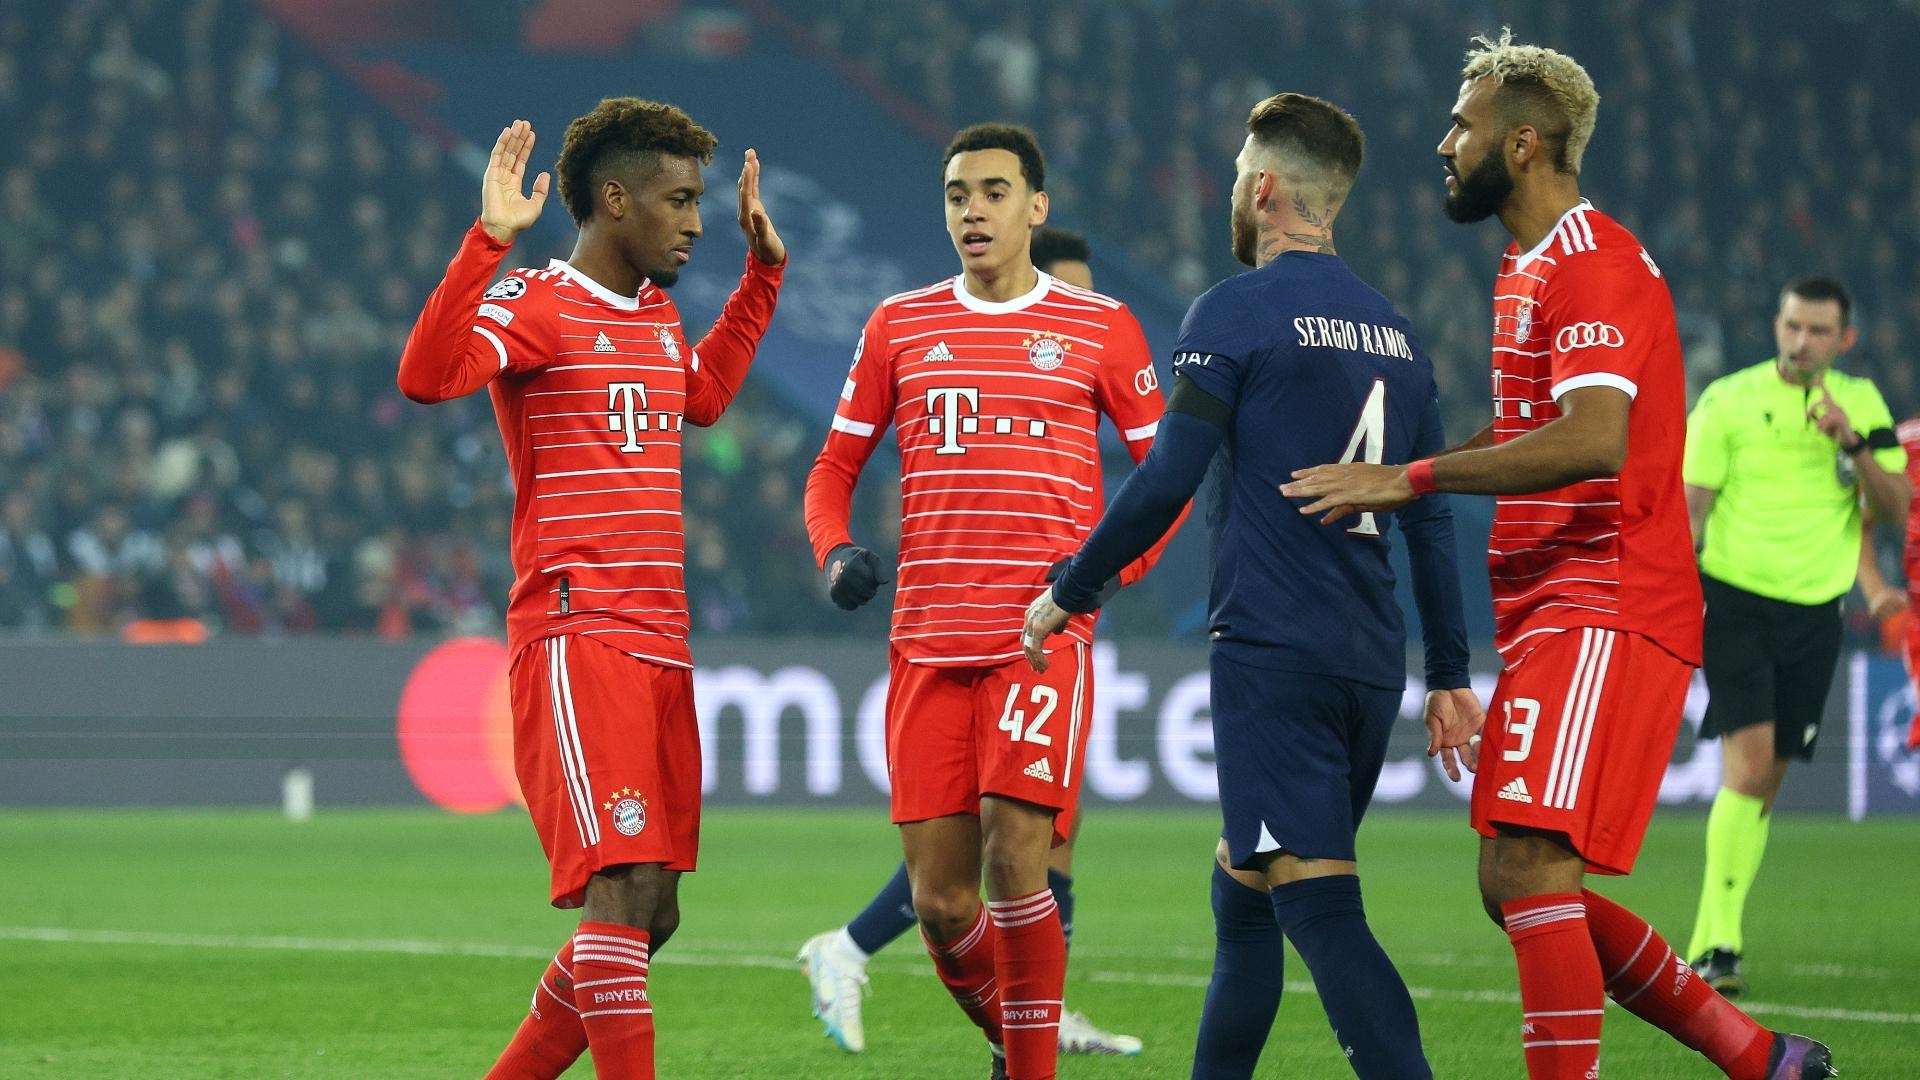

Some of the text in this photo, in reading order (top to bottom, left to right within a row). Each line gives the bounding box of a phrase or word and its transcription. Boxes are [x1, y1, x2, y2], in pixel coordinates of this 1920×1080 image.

[1294, 317, 1414, 361] SERGIO RAMOS
[1338, 379, 1385, 536] 4
[998, 683, 1058, 746] 42
[1024, 767, 1053, 783] adidas
[1497, 791, 1533, 803] adidas
[594, 989, 647, 1003] BAYERN
[1003, 1009, 1048, 1020] BAYERN
